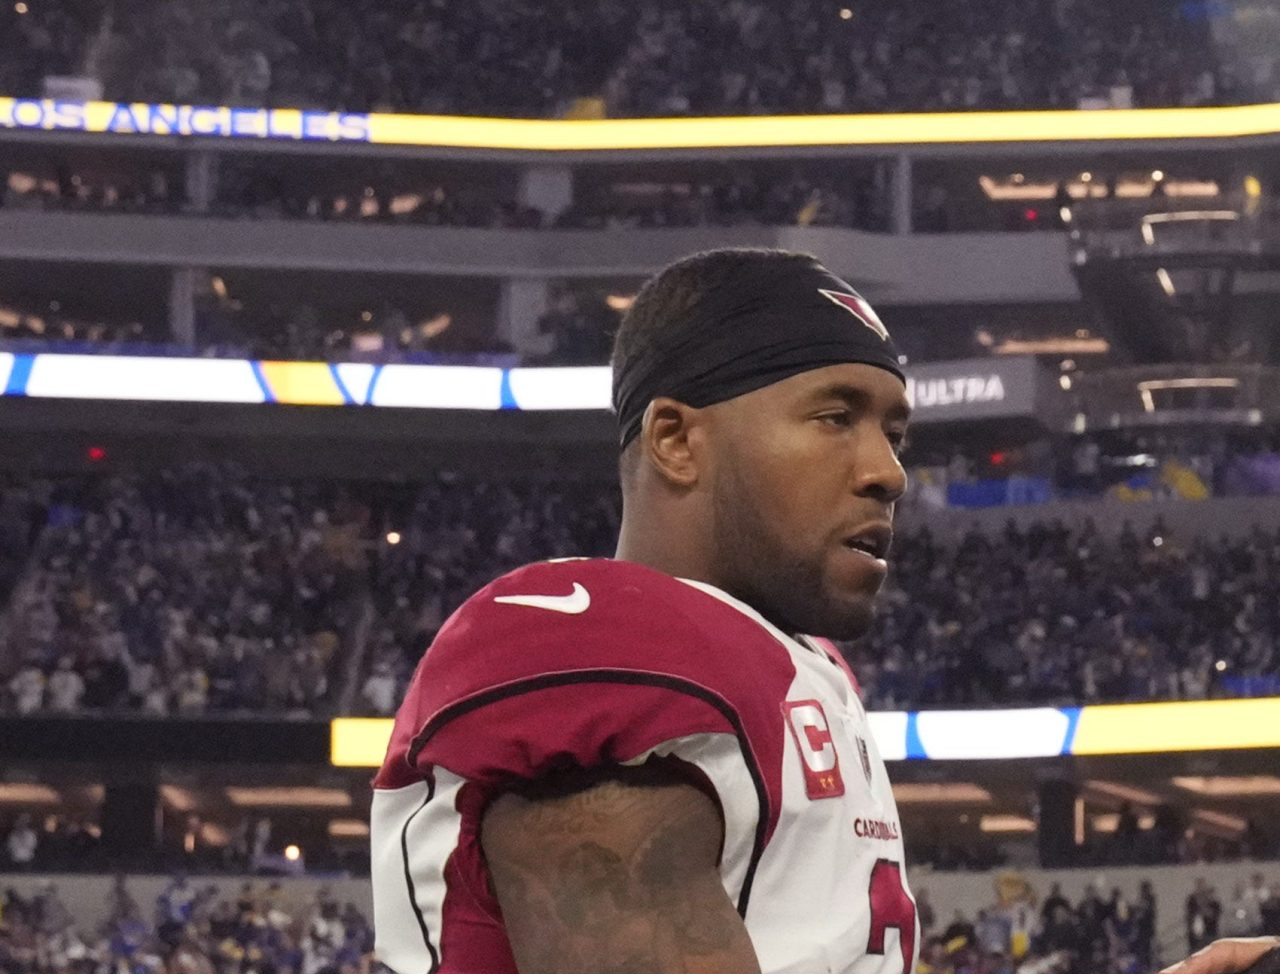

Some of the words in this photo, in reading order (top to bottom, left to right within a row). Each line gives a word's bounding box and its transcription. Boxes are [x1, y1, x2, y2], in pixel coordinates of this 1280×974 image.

[0, 98, 85, 129] OS
[109, 102, 368, 140] ANGELES
[917, 375, 1004, 407] ULTRA
[790, 705, 836, 772] C
